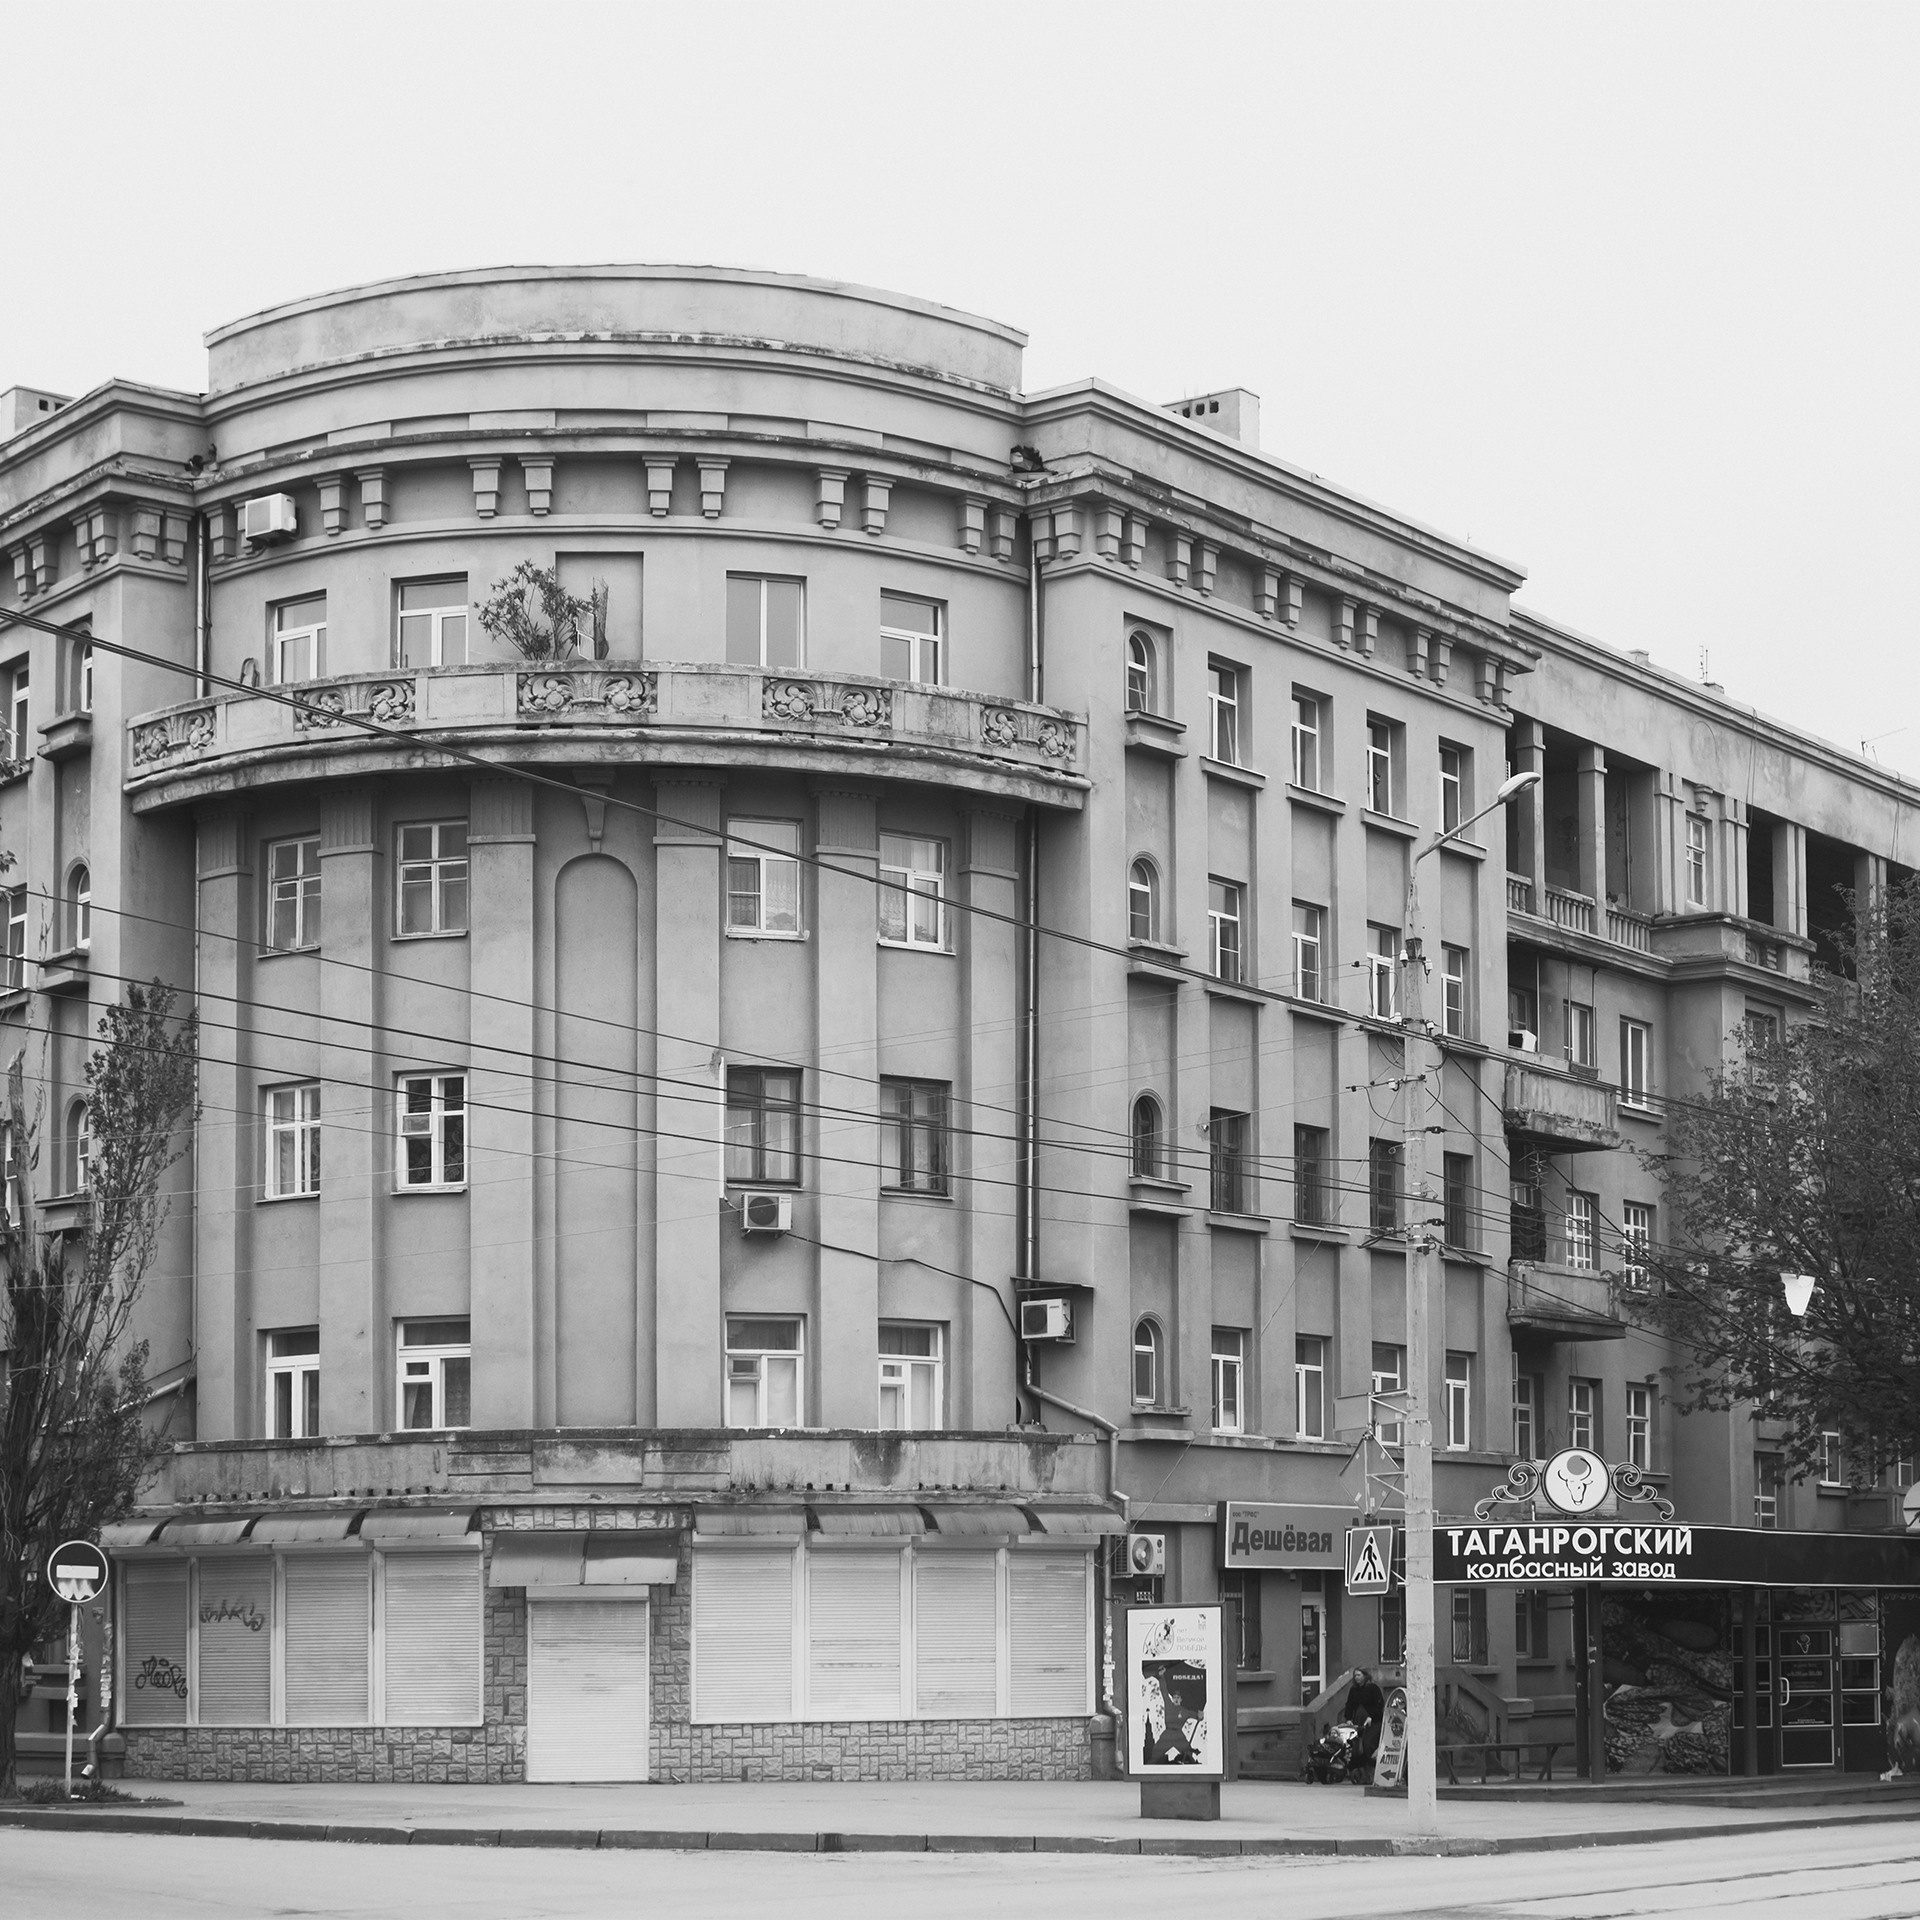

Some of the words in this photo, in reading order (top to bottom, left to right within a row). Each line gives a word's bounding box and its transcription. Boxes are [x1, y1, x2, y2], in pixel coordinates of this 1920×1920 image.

[1231, 1522, 1333, 1556] Дешёвая
[1447, 1527, 1693, 1556] ТАГАНРОГСКИЙ
[1466, 1555, 1604, 1579] колбасный
[1611, 1561, 1676, 1579] завод
[1139, 1621, 1175, 1655] 70
